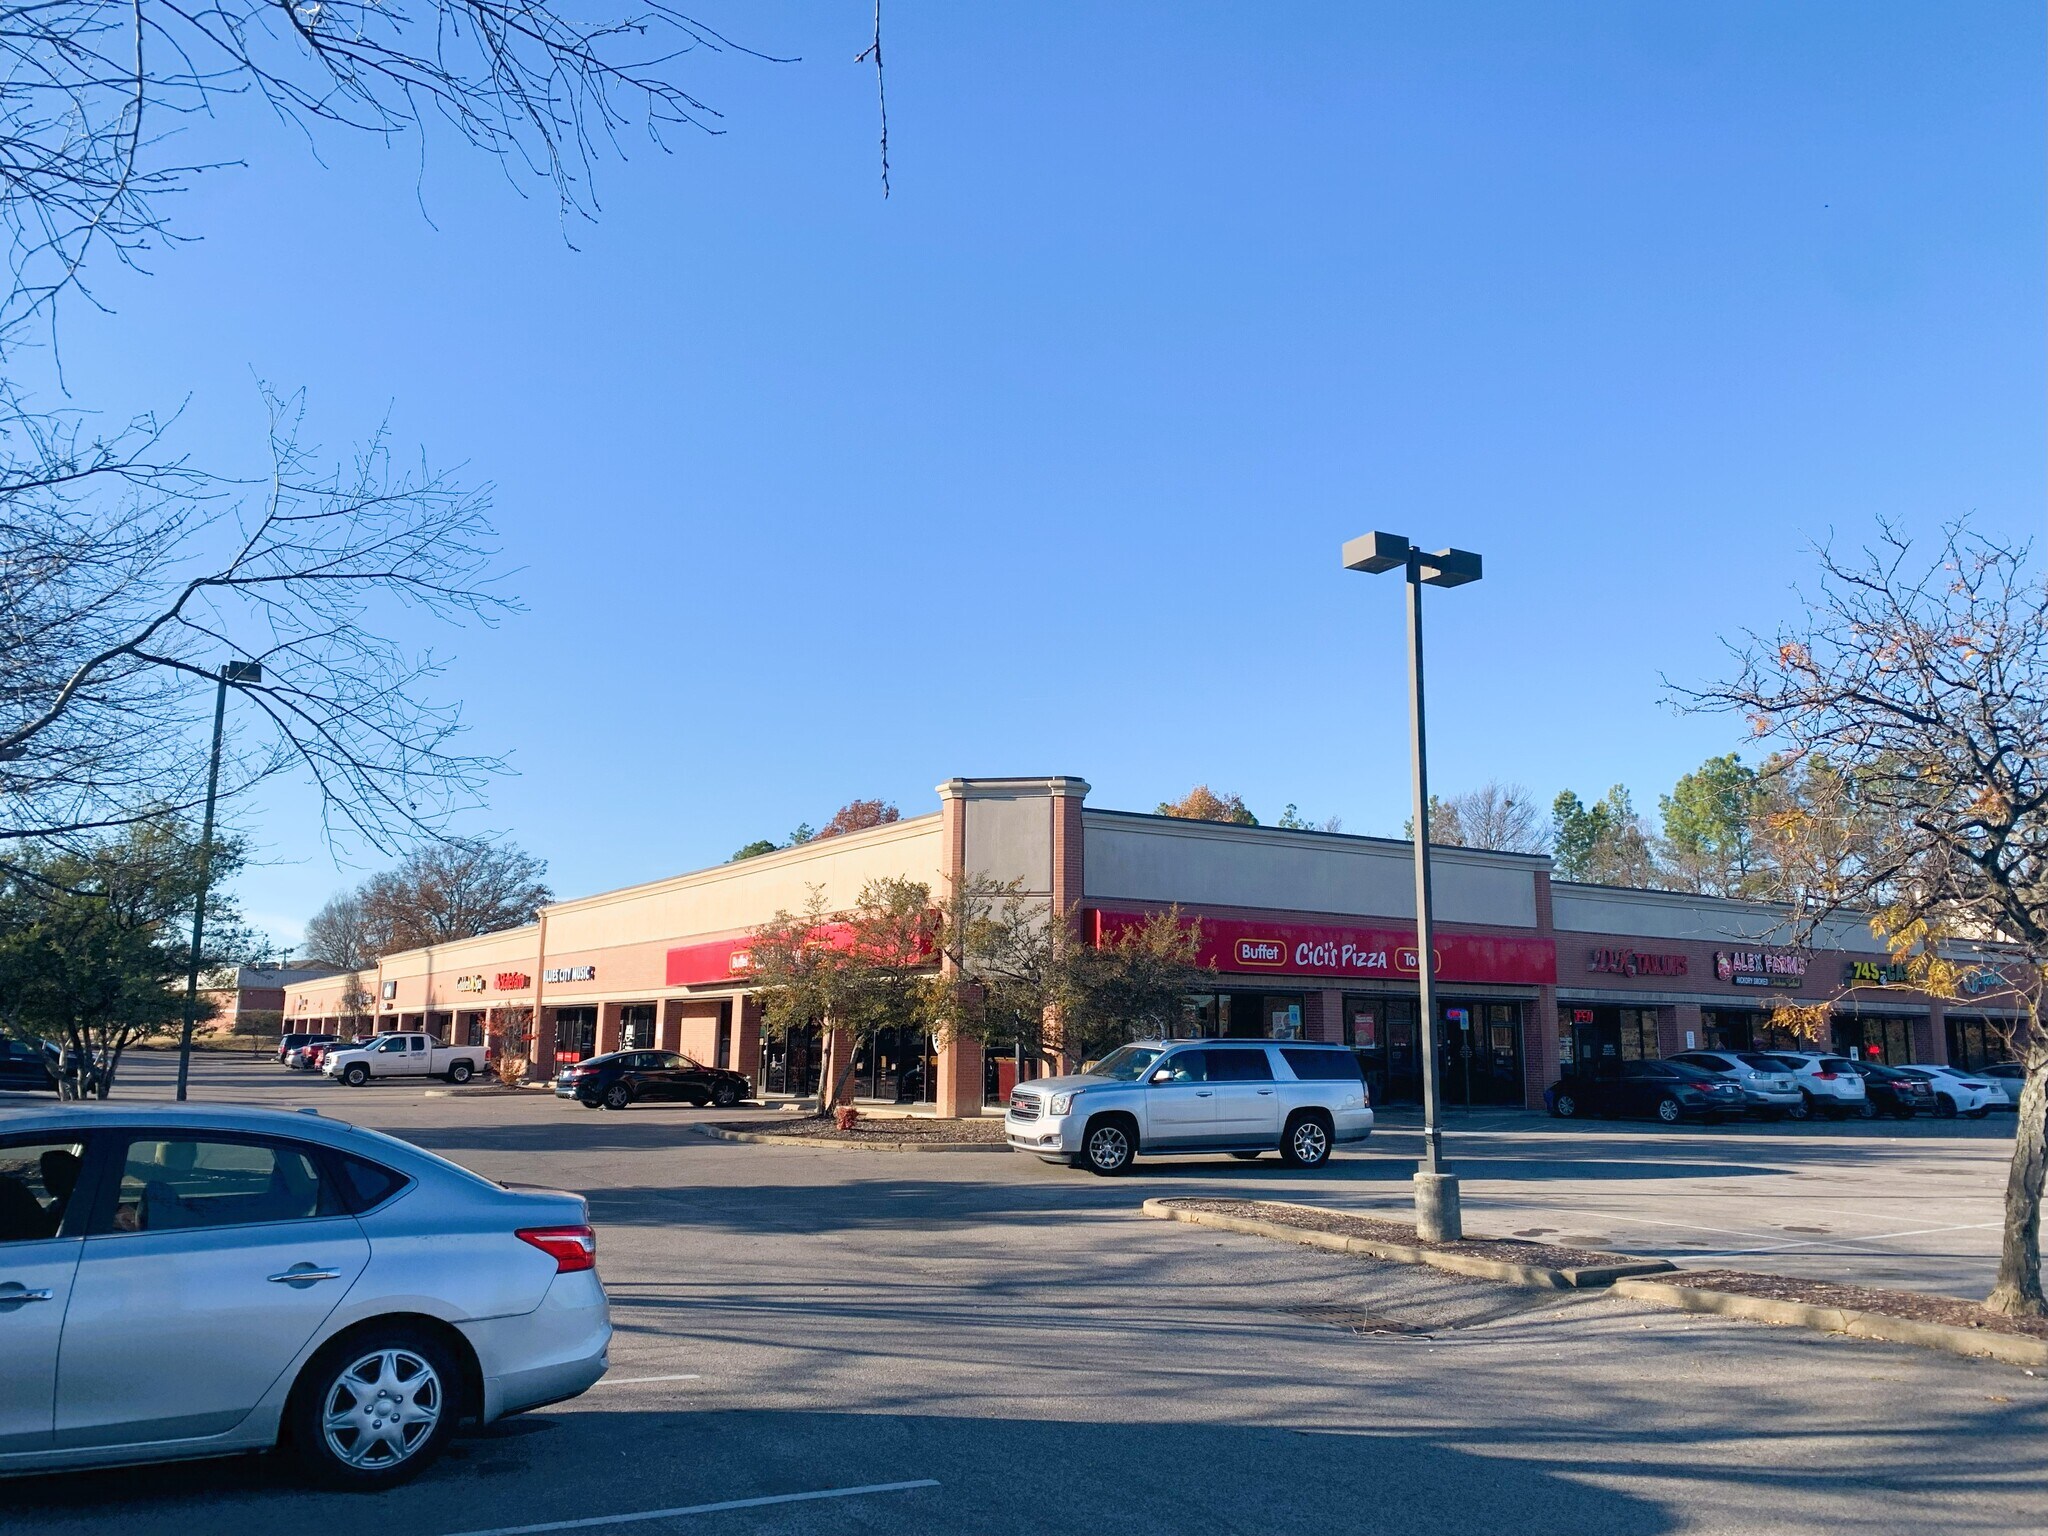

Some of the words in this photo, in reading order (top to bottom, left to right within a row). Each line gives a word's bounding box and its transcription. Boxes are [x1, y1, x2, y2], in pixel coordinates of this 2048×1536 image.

[1242, 944, 1279, 960] Buffet
[1403, 952, 1417, 967] To
[1733, 952, 1764, 972] ALEX
[572, 966, 590, 981] MUSIC
